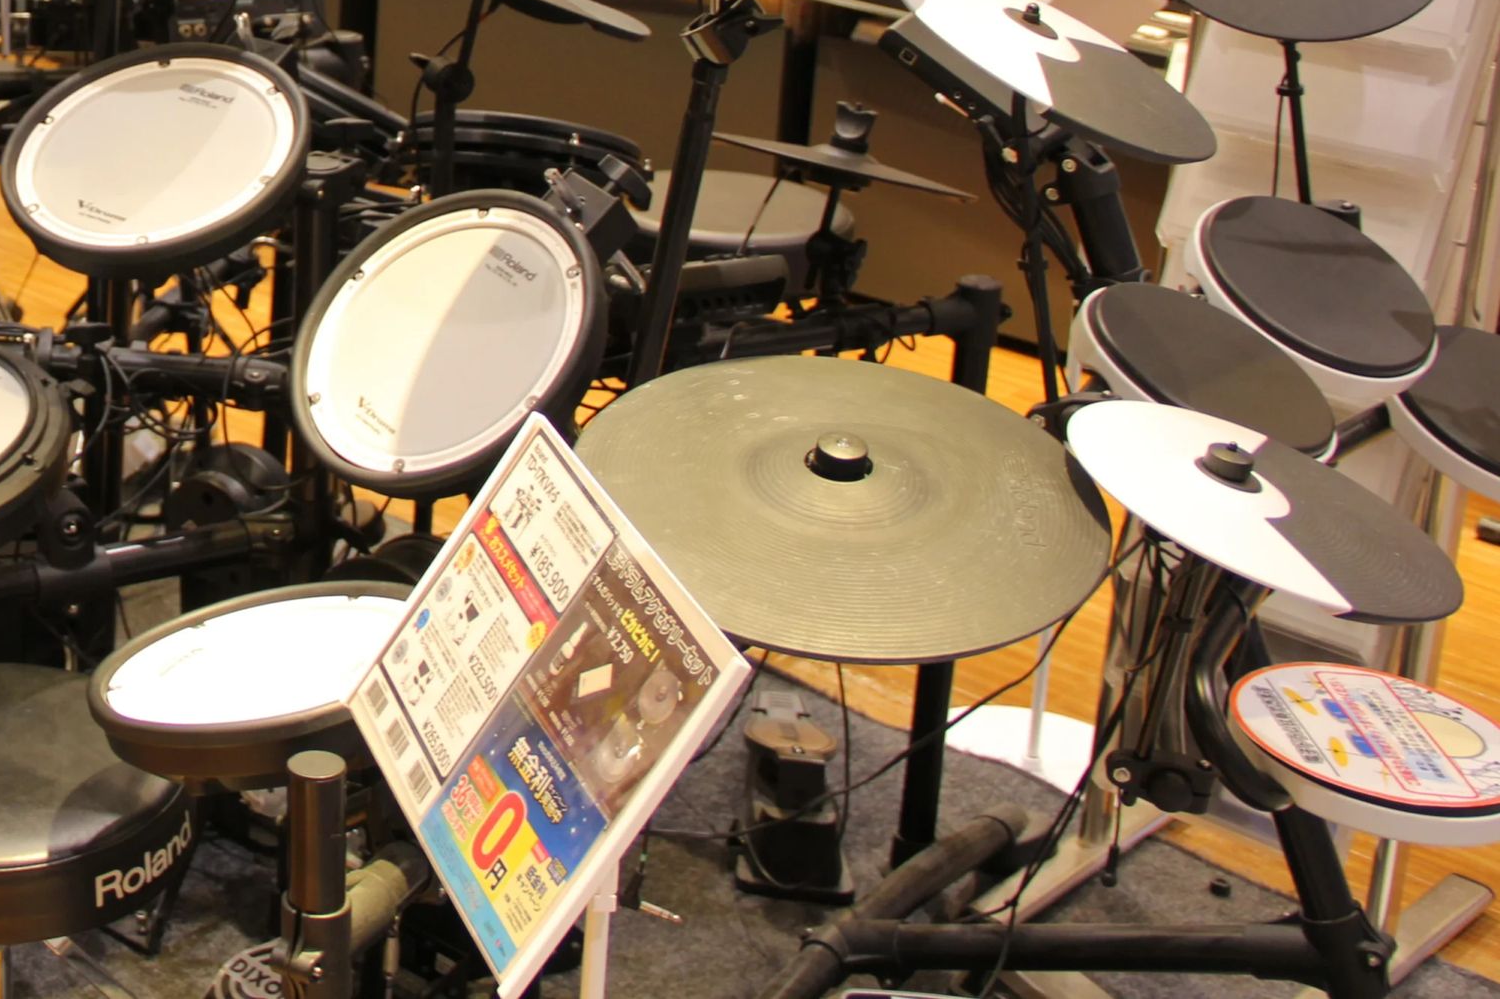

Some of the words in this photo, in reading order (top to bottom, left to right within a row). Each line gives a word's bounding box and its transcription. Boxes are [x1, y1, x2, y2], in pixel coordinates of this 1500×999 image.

[502, 250, 537, 282] Roland
[507, 733, 554, 801] 無金利
[95, 809, 192, 908] Roland
[230, 959, 282, 995] DIXO
